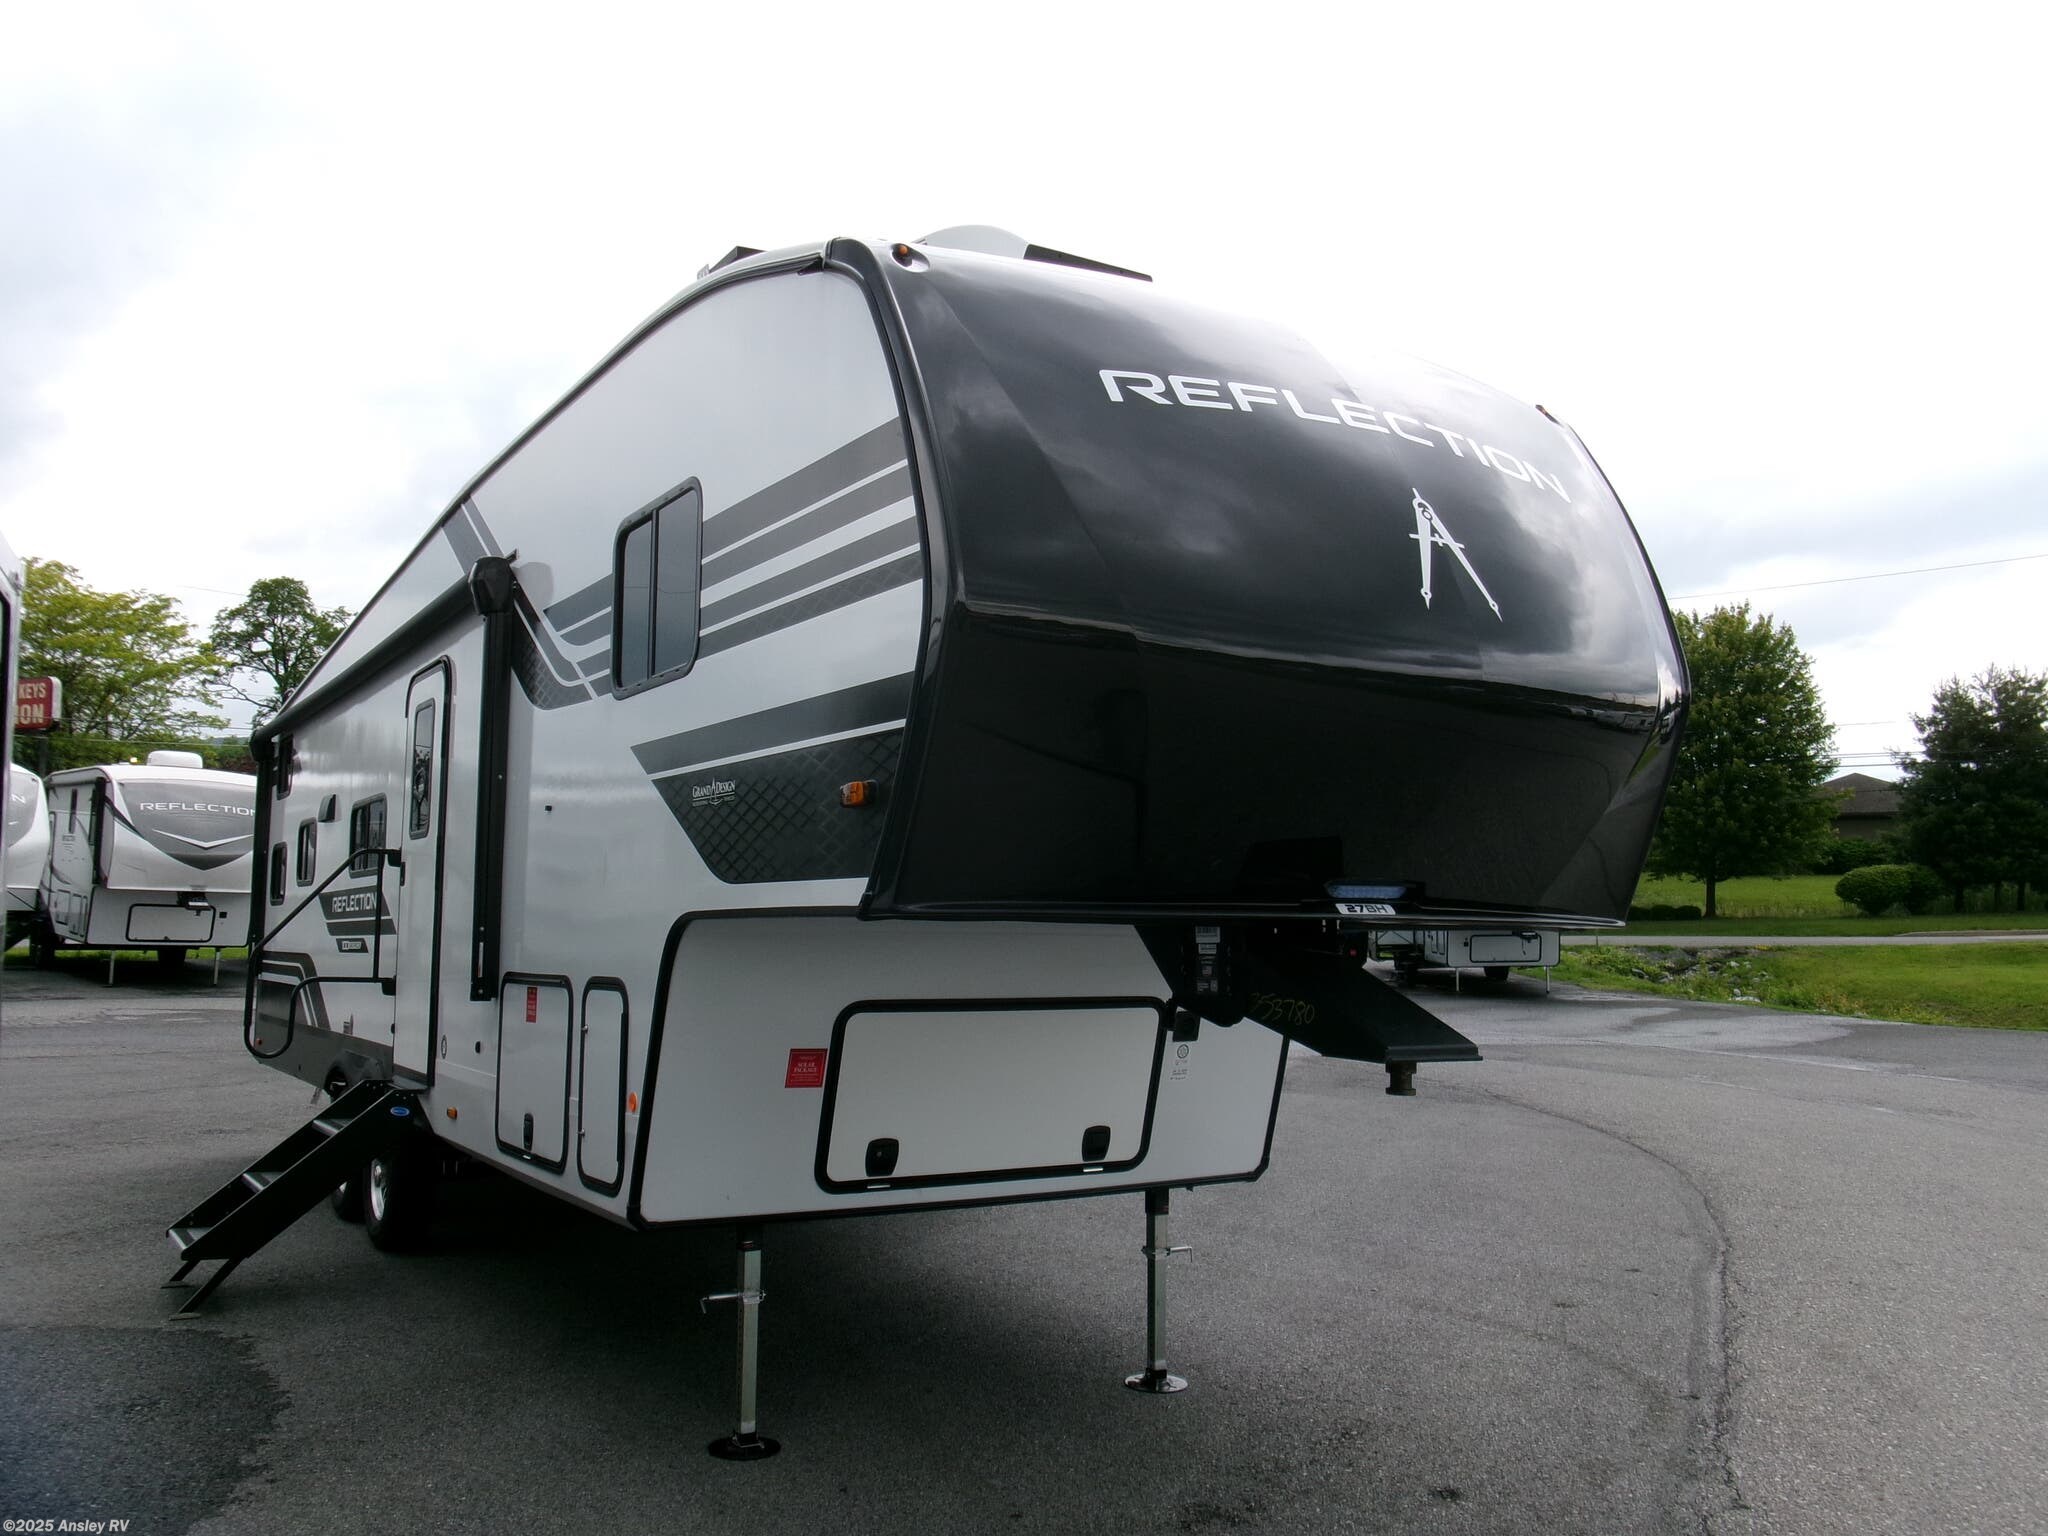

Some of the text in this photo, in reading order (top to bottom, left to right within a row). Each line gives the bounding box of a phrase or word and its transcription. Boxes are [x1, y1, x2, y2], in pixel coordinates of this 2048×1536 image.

[1099, 369, 1571, 503] REFLECTION
[715, 780, 736, 794] DESIGN
[331, 892, 377, 912] REFLECTION
[1344, 904, 1389, 913] 27BH
